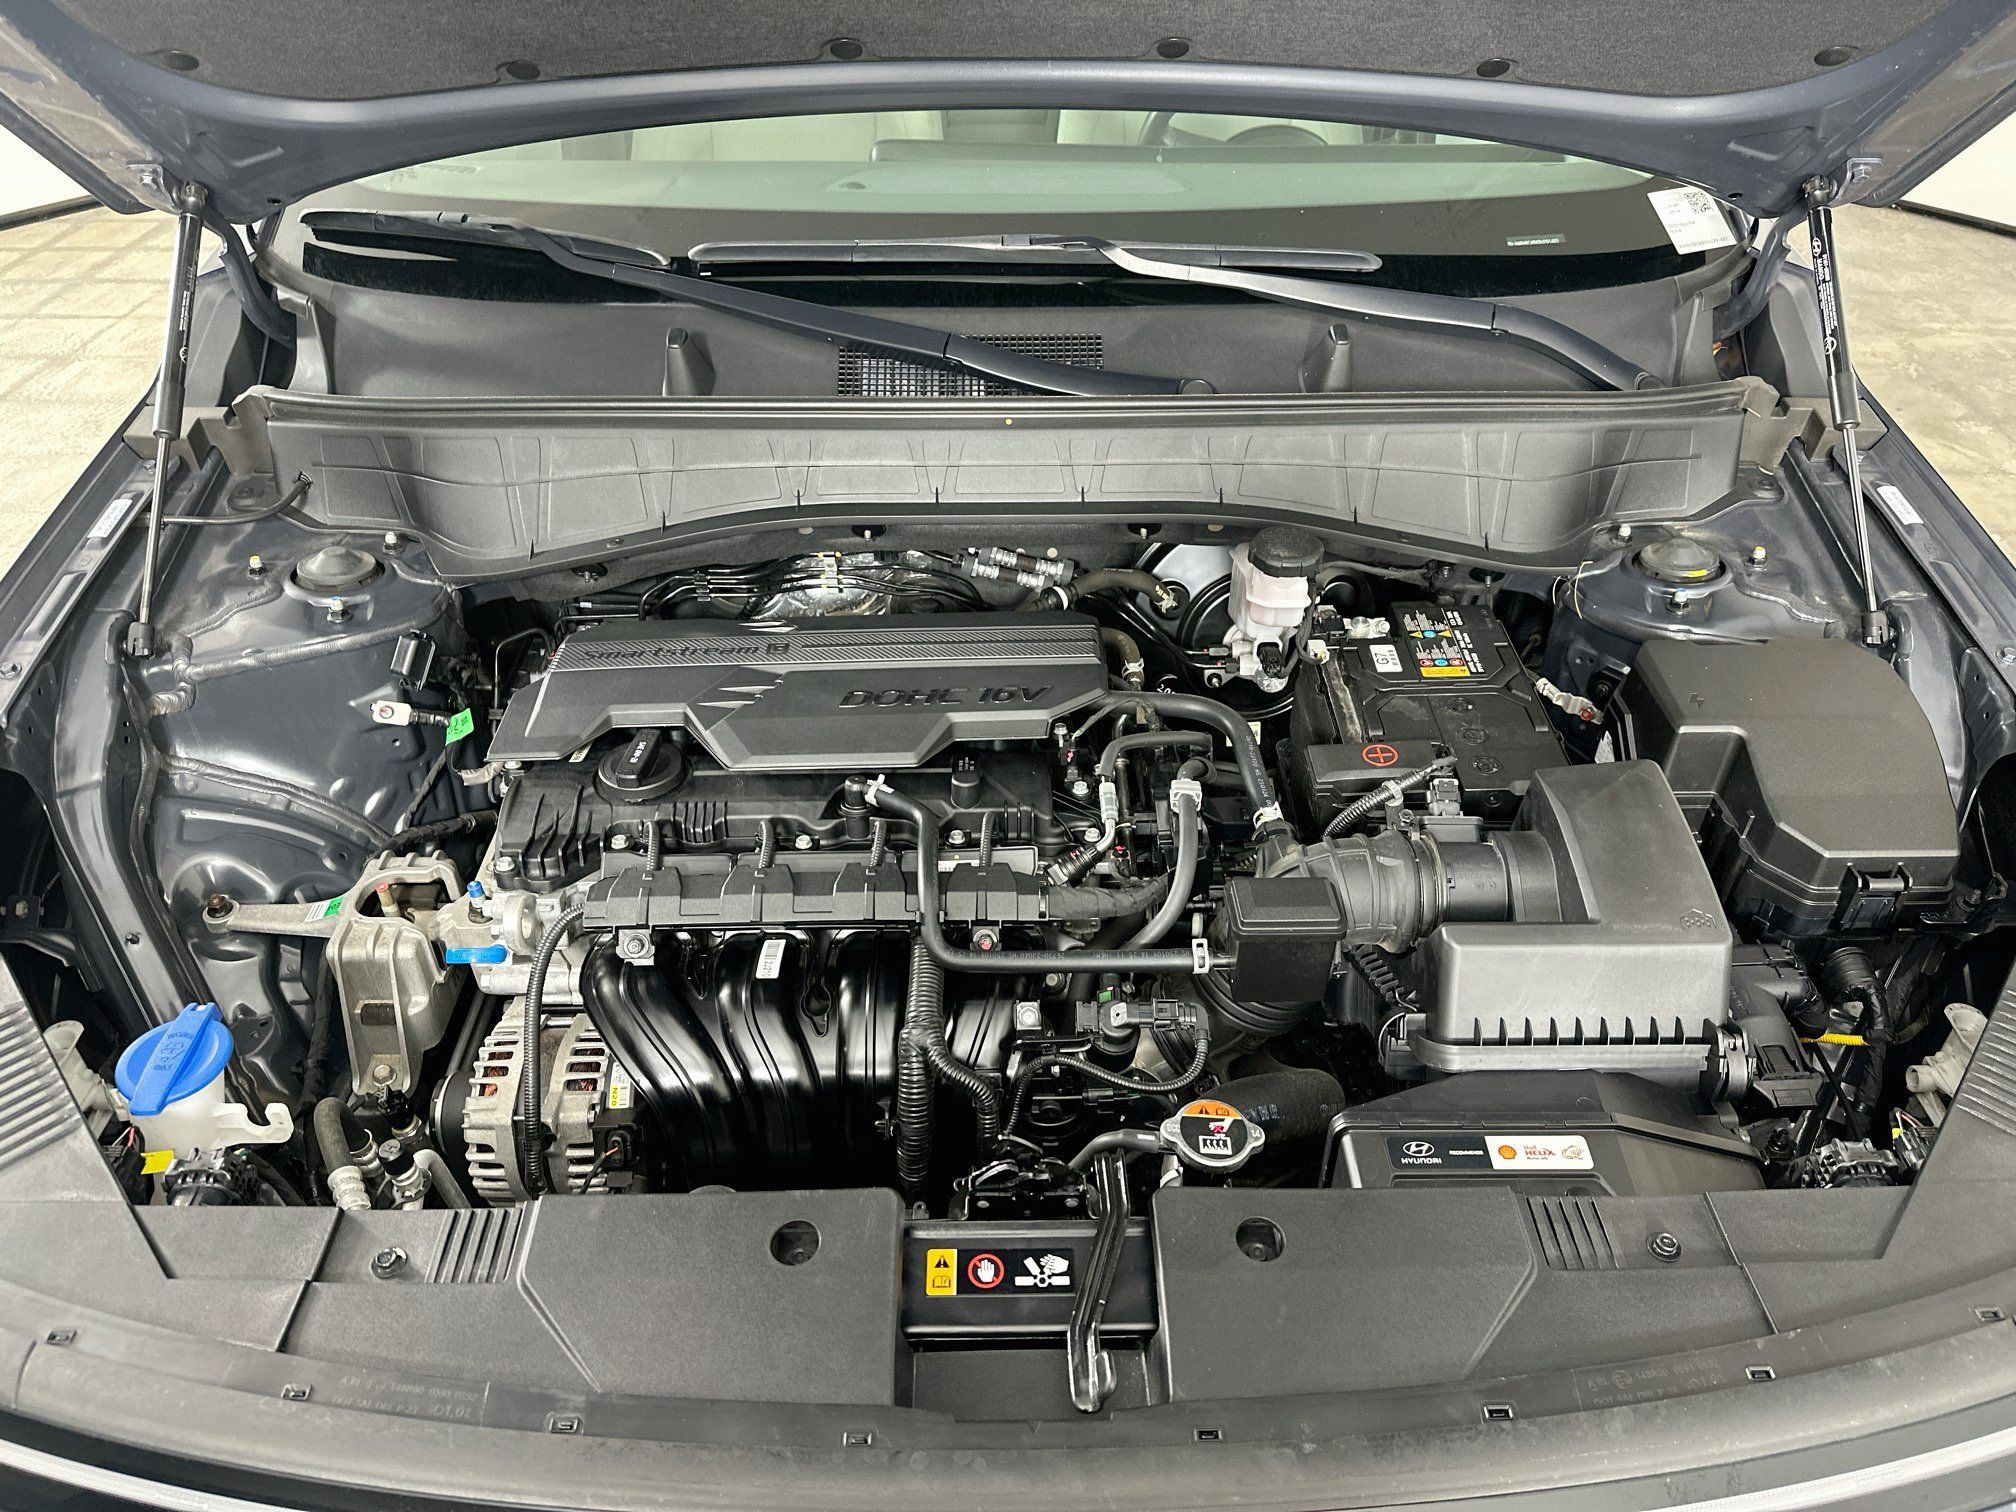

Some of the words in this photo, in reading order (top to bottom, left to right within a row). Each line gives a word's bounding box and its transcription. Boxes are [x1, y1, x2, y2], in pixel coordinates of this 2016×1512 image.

[584, 645, 759, 660] Smartstream
[1374, 652, 1389, 665] G7
[838, 687, 969, 708] DOHC
[978, 685, 1053, 704] 16V
